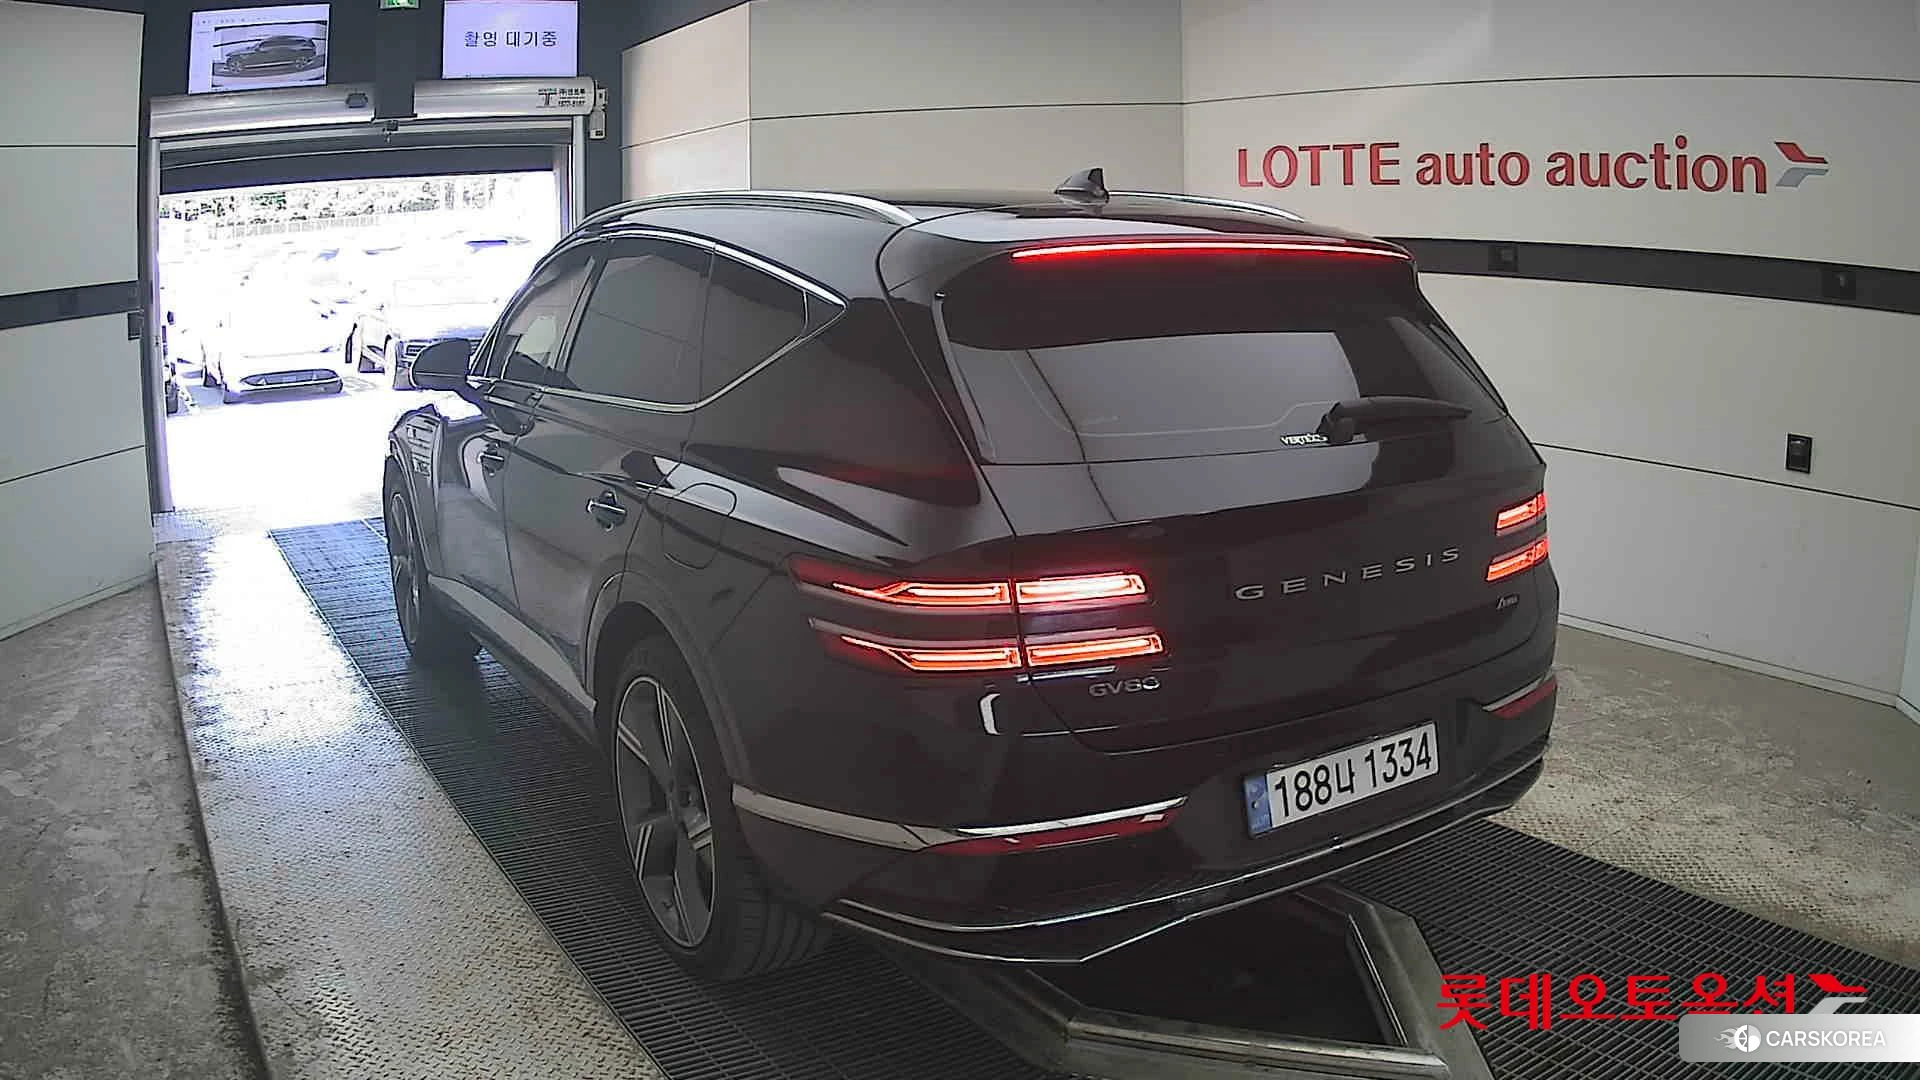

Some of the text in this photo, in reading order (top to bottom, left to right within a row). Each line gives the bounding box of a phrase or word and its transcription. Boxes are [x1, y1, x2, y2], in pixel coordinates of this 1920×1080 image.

[464, 31, 558, 47] 촬영 대기중
[1237, 135, 1768, 194] LOTTE auto auction
[1235, 547, 1459, 600] GENESIS
[1088, 676, 1161, 697] GV80
[1274, 732, 1432, 817] 188나 1334
